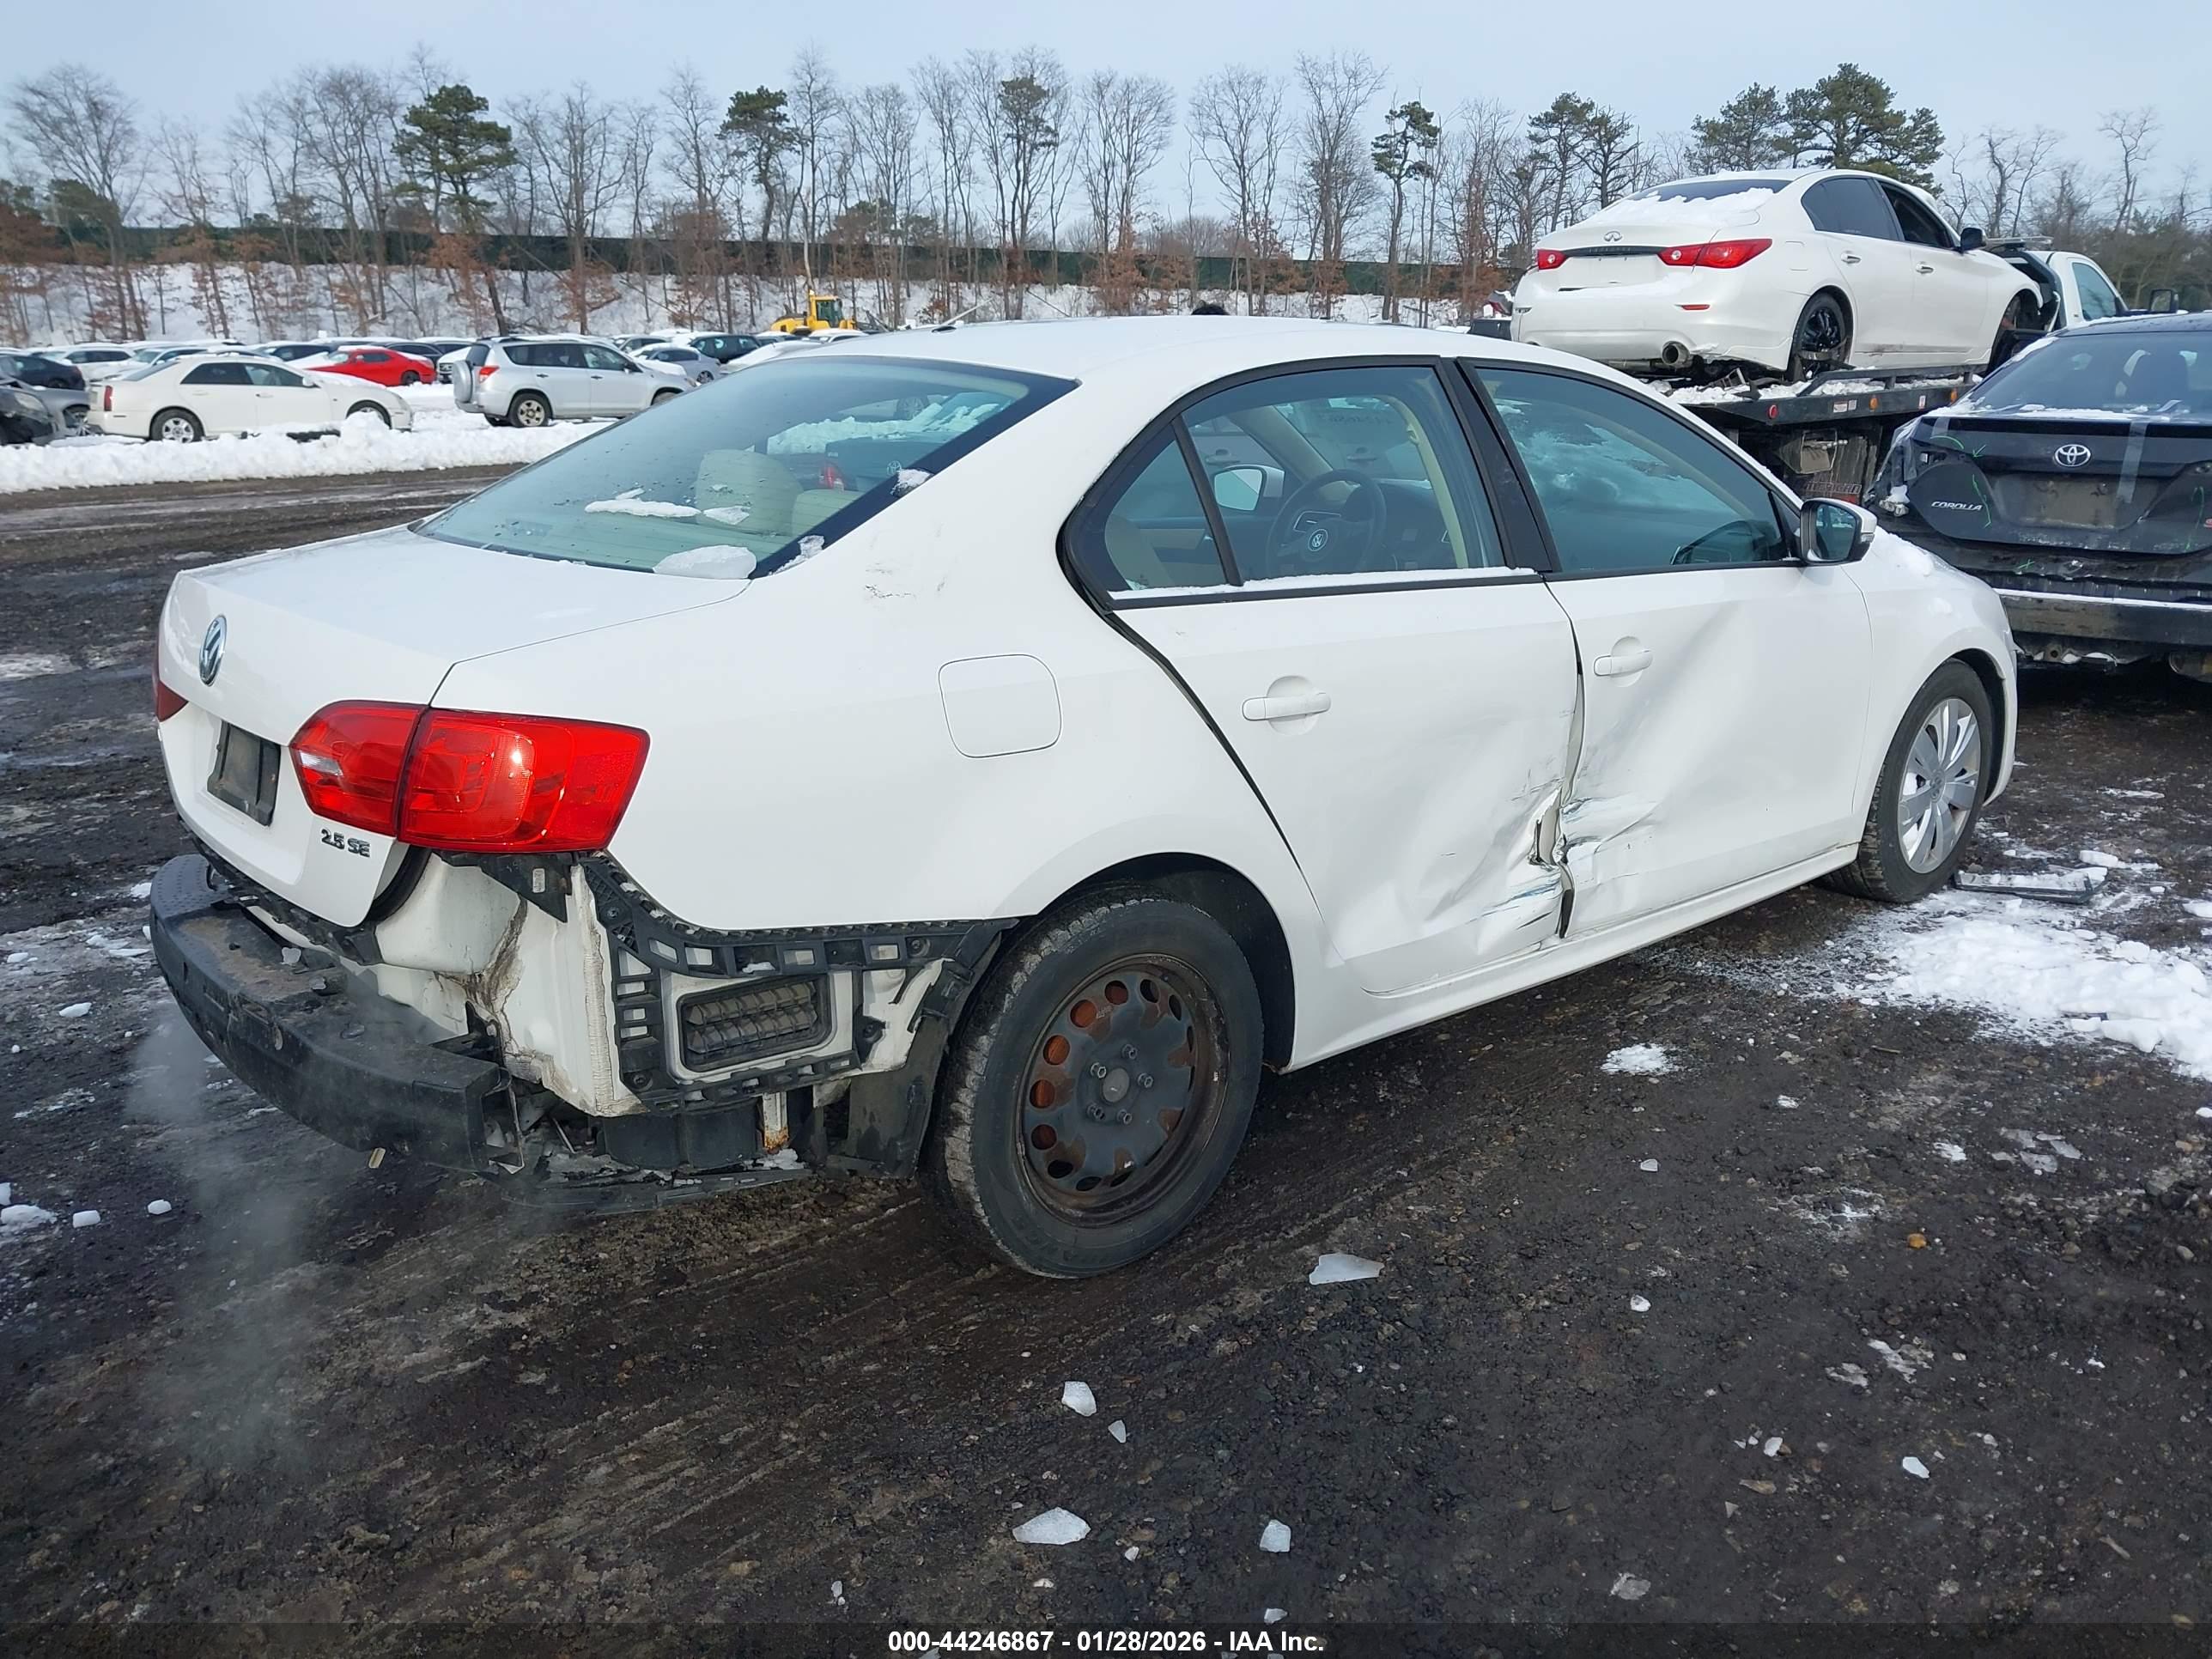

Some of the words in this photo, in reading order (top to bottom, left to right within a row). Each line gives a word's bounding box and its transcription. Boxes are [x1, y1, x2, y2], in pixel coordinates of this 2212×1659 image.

[1931, 501, 1983, 511] COROLLA
[321, 829, 345, 849] 2.5
[347, 838, 370, 858] SE
